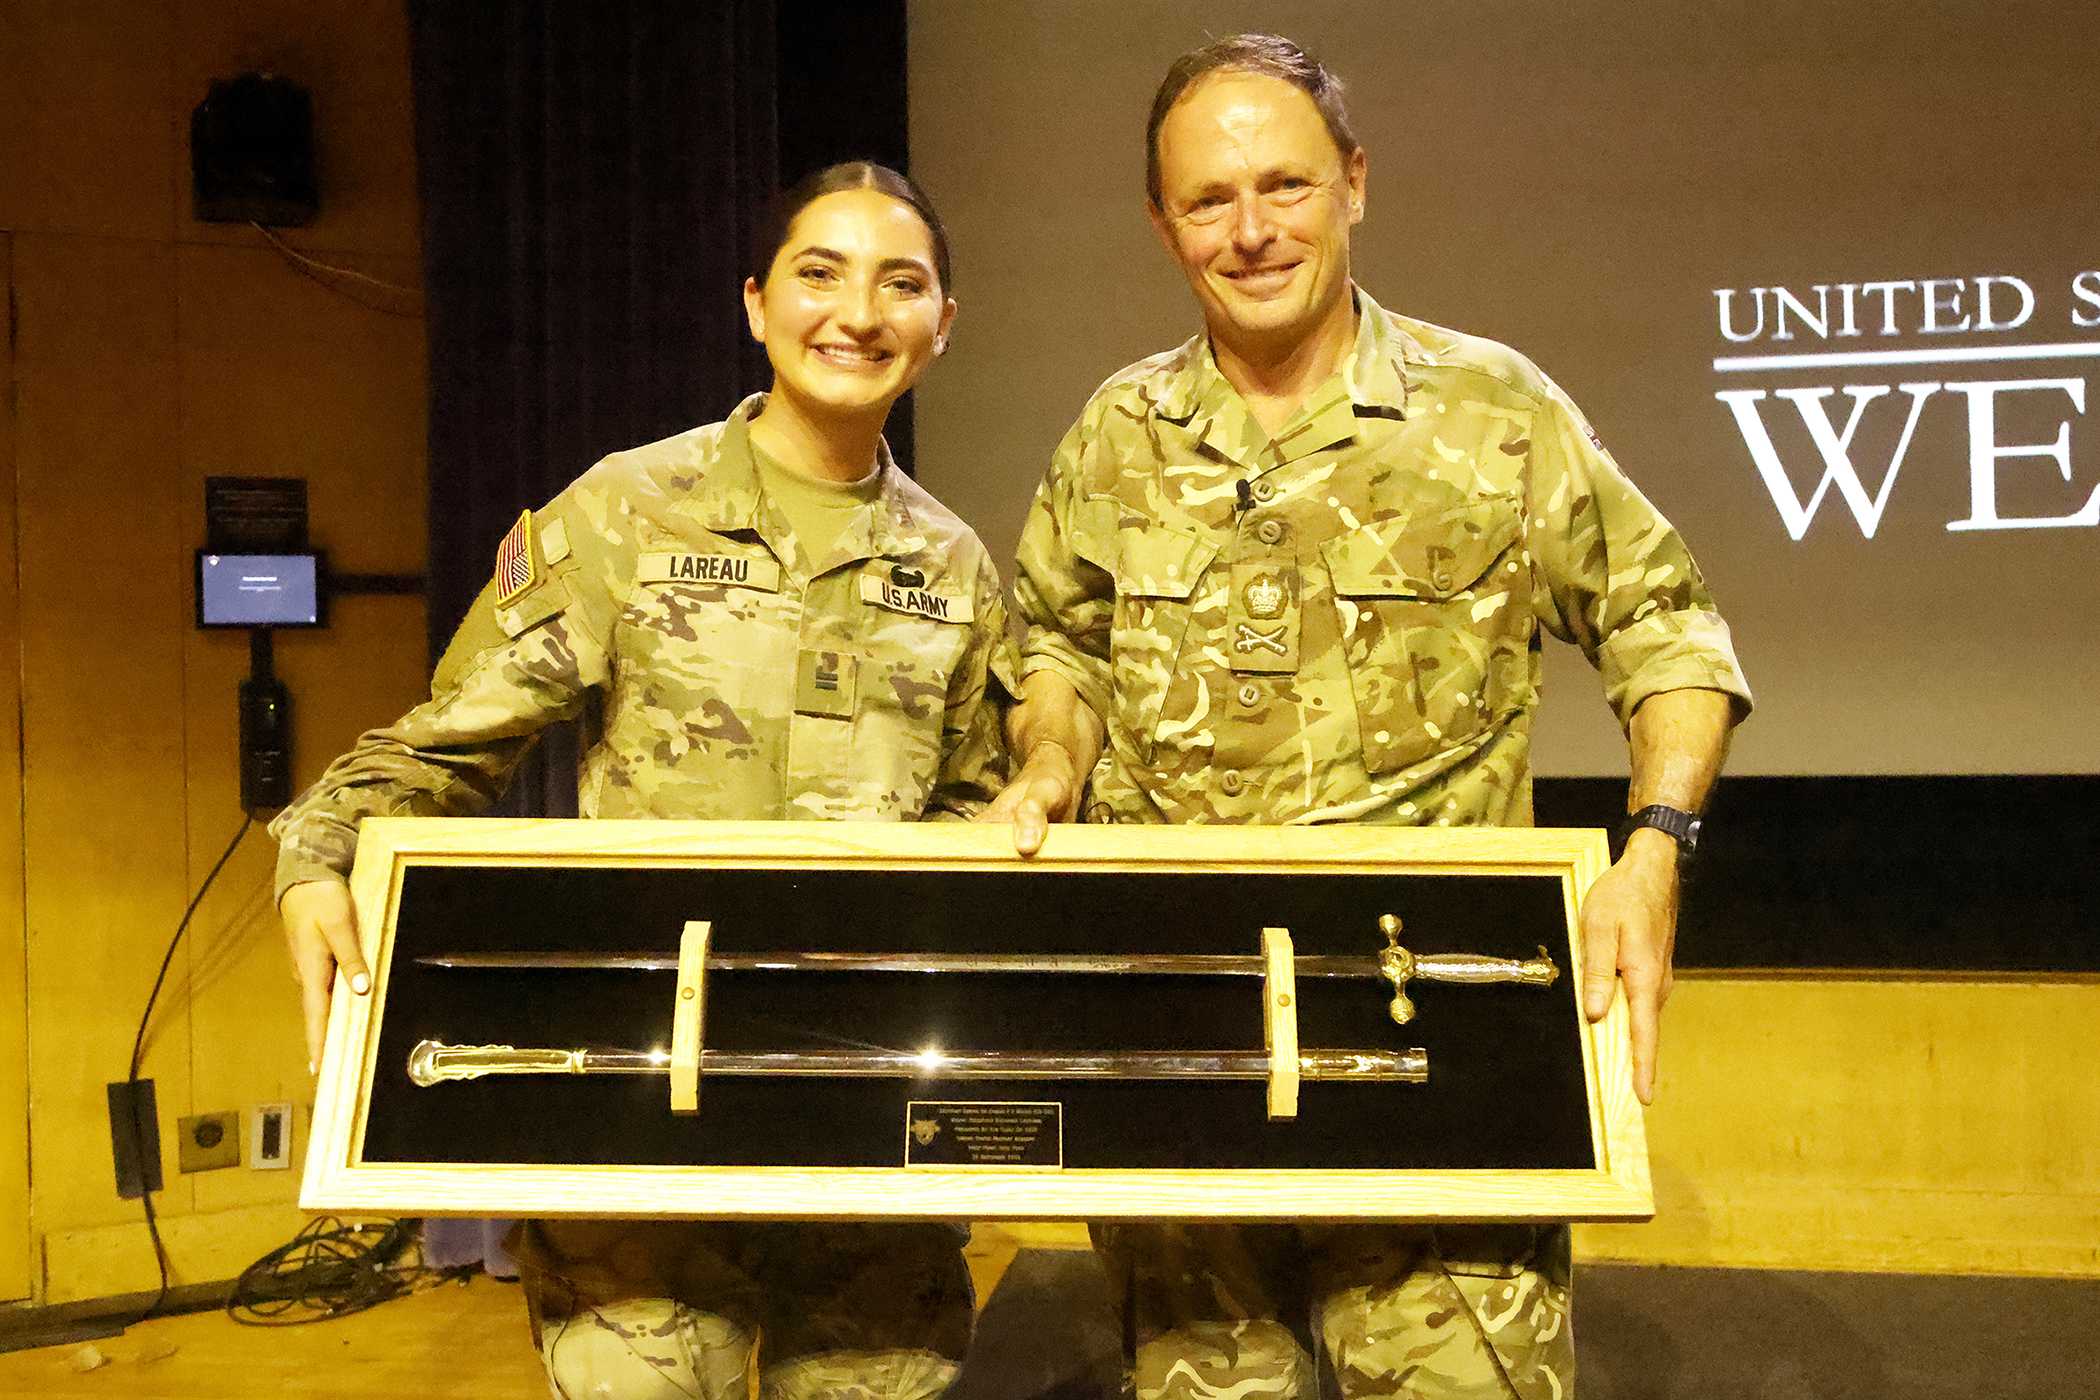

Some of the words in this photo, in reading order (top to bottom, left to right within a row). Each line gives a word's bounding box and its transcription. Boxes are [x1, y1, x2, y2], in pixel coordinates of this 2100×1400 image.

[1712, 275, 2035, 343] UNITED
[1714, 377, 2100, 541] WE
[669, 555, 748, 582] LAREAU
